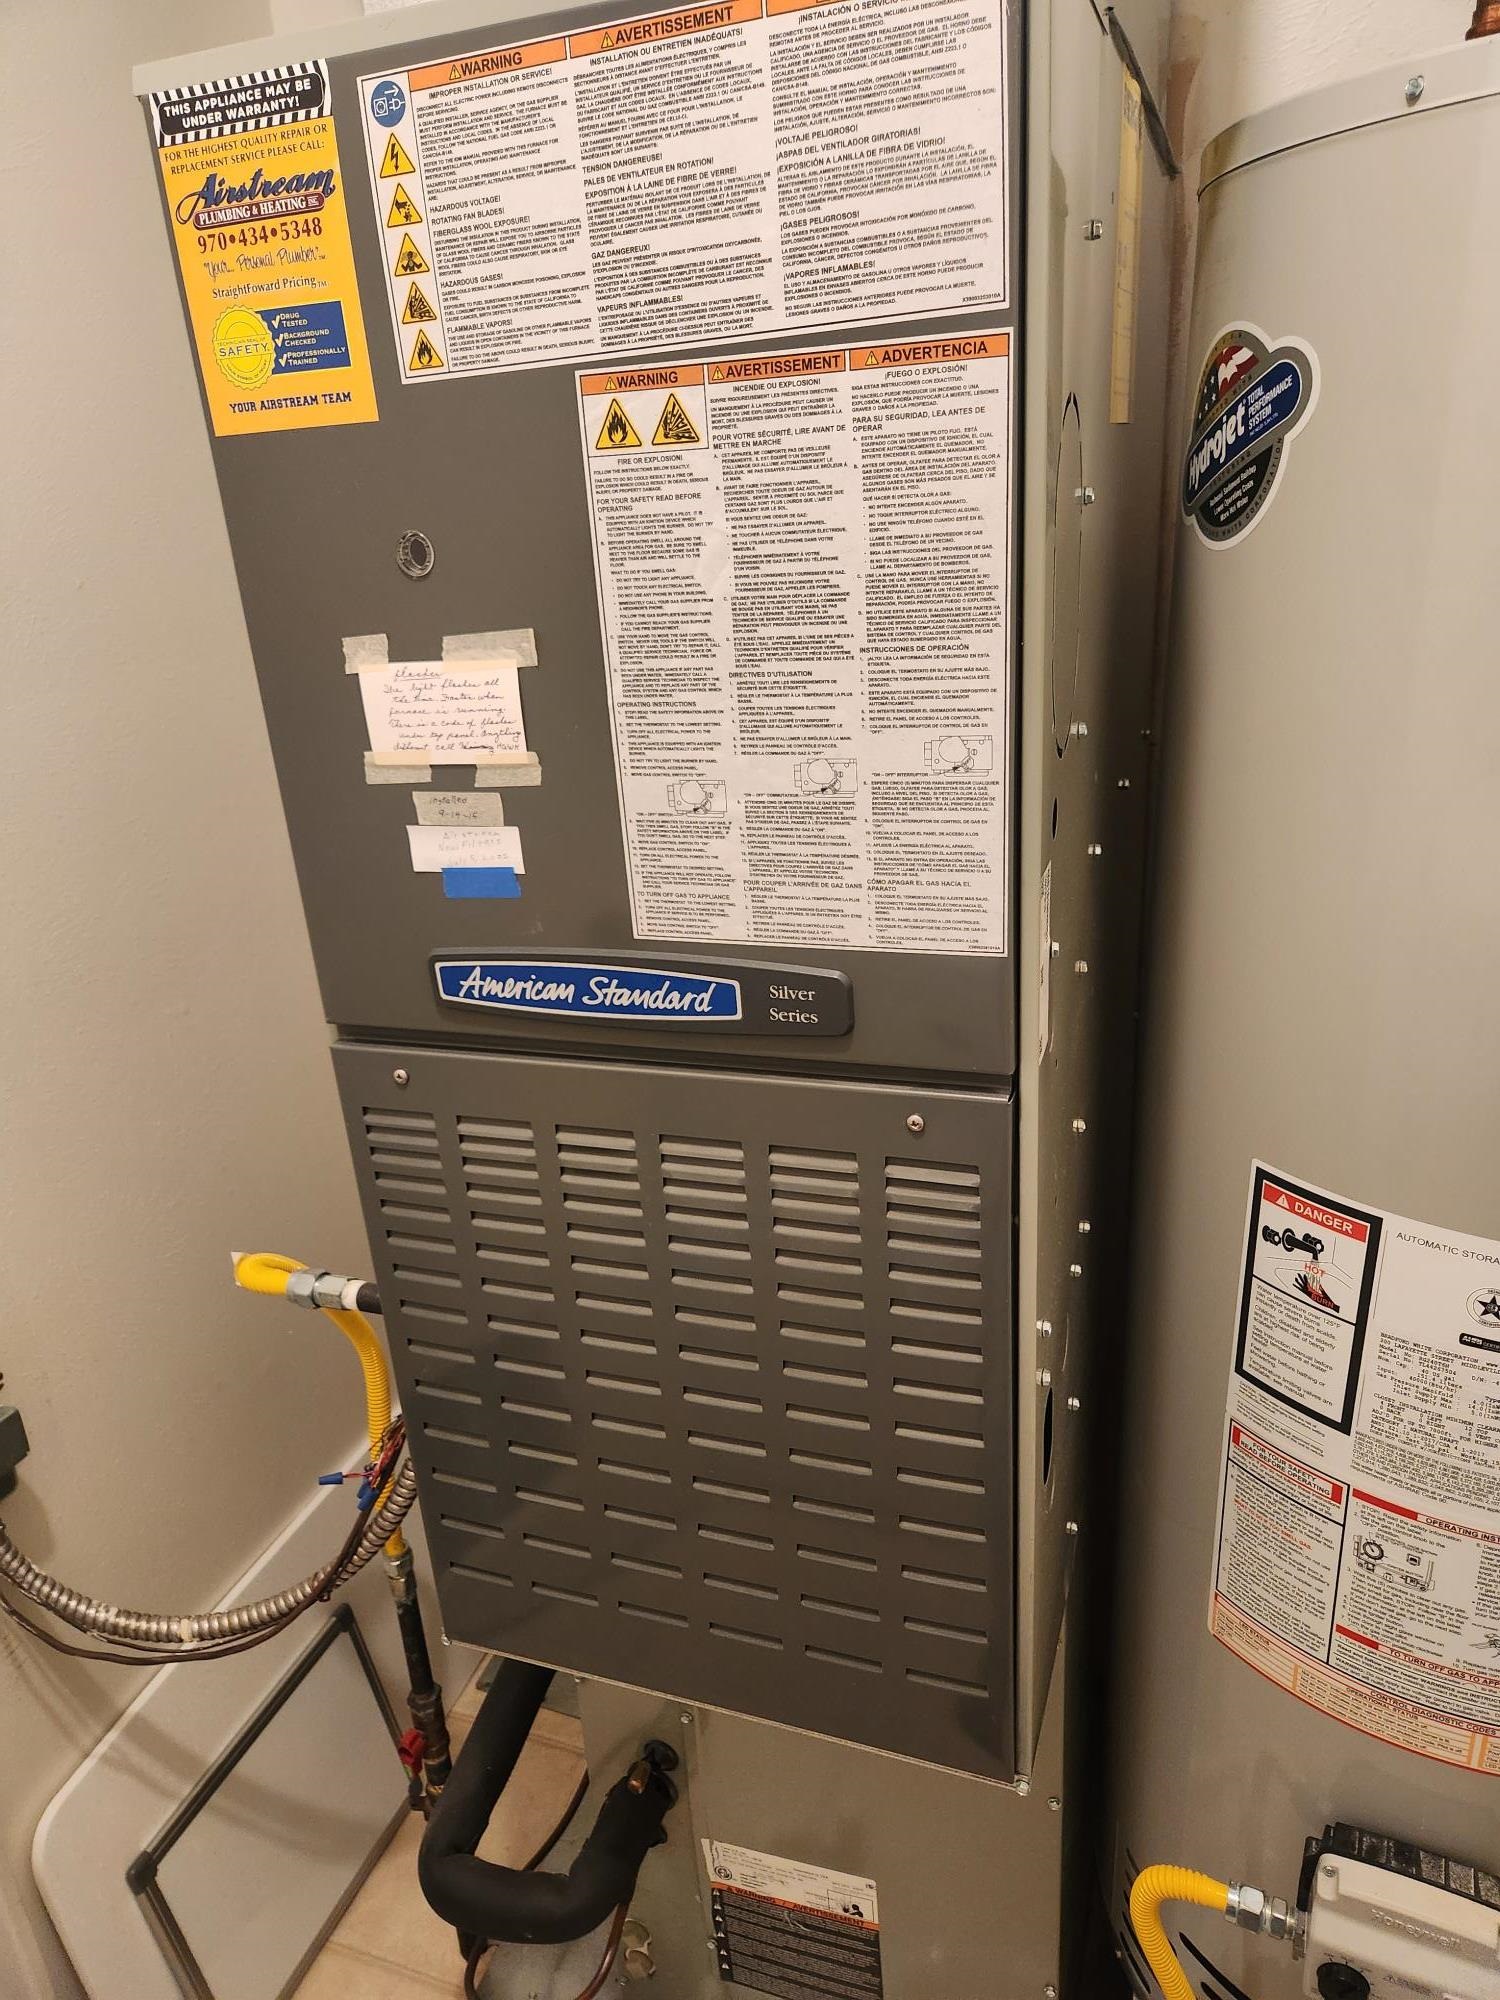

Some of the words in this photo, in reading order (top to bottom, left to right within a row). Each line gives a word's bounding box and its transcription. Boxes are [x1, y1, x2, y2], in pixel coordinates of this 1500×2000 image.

[615, 6, 733, 44] AVERTISSEMENT
[460, 52, 522, 76] WARNING
[429, 85, 462, 99] IMPROPER
[463, 76, 510, 92] INSTALLATION
[510, 75, 520, 83] OR
[521, 68, 553, 81] SERVICE!
[164, 102, 190, 118] THIS
[194, 90, 262, 111] APPLIANCE
[266, 83, 291, 98] MAY
[295, 78, 311, 91] BE
[182, 111, 222, 128] UNDER
[226, 96, 300, 121] WARRANTY!
[164, 151, 181, 162] FOR
[184, 147, 199, 158] THE
[201, 141, 237, 156] HIGHEST
[240, 133, 278, 148] QUALITY
[281, 127, 310, 140] REPAIR
[313, 123, 328, 135] OR
[171, 157, 229, 175] REPLACEMENT
[231, 150, 265, 165] SERVICE
[267, 145, 297, 158] PLEASE
[299, 140, 324, 152] CALL:
[176, 168, 336, 225] Airstream
[430, 200, 468, 213] HAZARDOUS
[470, 195, 501, 206] VOLTAGE!
[199, 206, 251, 226] PLUMBING
[252, 205, 259, 214] &
[260, 197, 306, 214] HEATING
[431, 214, 462, 226] ROTATING
[464, 212, 476, 220] FAN
[477, 207, 505, 218] BLADES!
[433, 225, 472, 237] FIBERGLASS
[473, 223, 492, 231] WOOL
[494, 216, 530, 227] EXPOSURE!
[213, 279, 279, 300] StraightFoward
[440, 277, 478, 289] HAZARDOUS
[480, 273, 503, 282] GASES!
[280, 312, 300, 320] DRUG
[282, 319, 308, 328] TESTED
[447, 323, 484, 334] FLAMMABLE
[485, 319, 512, 328] VAPORS!
[283, 329, 329, 340] BACKGROUND
[285, 338, 316, 347] CHECKED
[219, 343, 268, 357] SAFETY
[287, 347, 346, 359] PROFESSIONALLY
[882, 341, 988, 364] ADVERTENCIA
[288, 358, 318, 366] TRAINED
[726, 355, 840, 378] AVERTISSEMENT
[616, 371, 678, 388] WARNING
[733, 385, 765, 393] INCENDIE
[779, 378, 820, 388] EXPLOSION!
[229, 401, 256, 413] YOUR
[260, 394, 318, 410] AIRSTREAM
[321, 392, 352, 403] TEAM
[1248, 385, 1264, 406] TOTAL
[1248, 374, 1293, 418] PERFORMANCE
[1248, 404, 1272, 430] SYSTEM
[852, 424, 883, 432] OPERAR
[644, 454, 682, 463] EXPLOSION!
[675, 492, 701, 500] BEFORE
[597, 505, 633, 513] OPERATING
[458, 966, 575, 1003] American
[582, 976, 716, 1014] Standard
[770, 985, 816, 1001] Silver
[770, 1007, 819, 1024] Series
[1294, 1202, 1353, 1234] DANGER
[1396, 1232, 1459, 1255] AUTOMATIC
[1304, 1262, 1325, 1278] HOT
[1241, 1440, 1258, 1455] READ
[1259, 1452, 1286, 1472] BEFORE
[1287, 1470, 1330, 1495] OPERATING
[1253, 1442, 1266, 1454] FOR
[1267, 1451, 1286, 1466] YOUR
[1288, 1463, 1316, 1482] SAFETY
[1425, 1517, 1479, 1538] OPERATING
[1390, 1650, 1401, 1658] TO
[1404, 1655, 1426, 1667] TURN
[1428, 1663, 1446, 1672] OFF
[1447, 1669, 1466, 1679] GAS
[1370, 1690, 1411, 1709] CONTROL
[1412, 1707, 1464, 1727] DIAGNOSTIC
[1466, 1724, 1496, 1736] CODES
